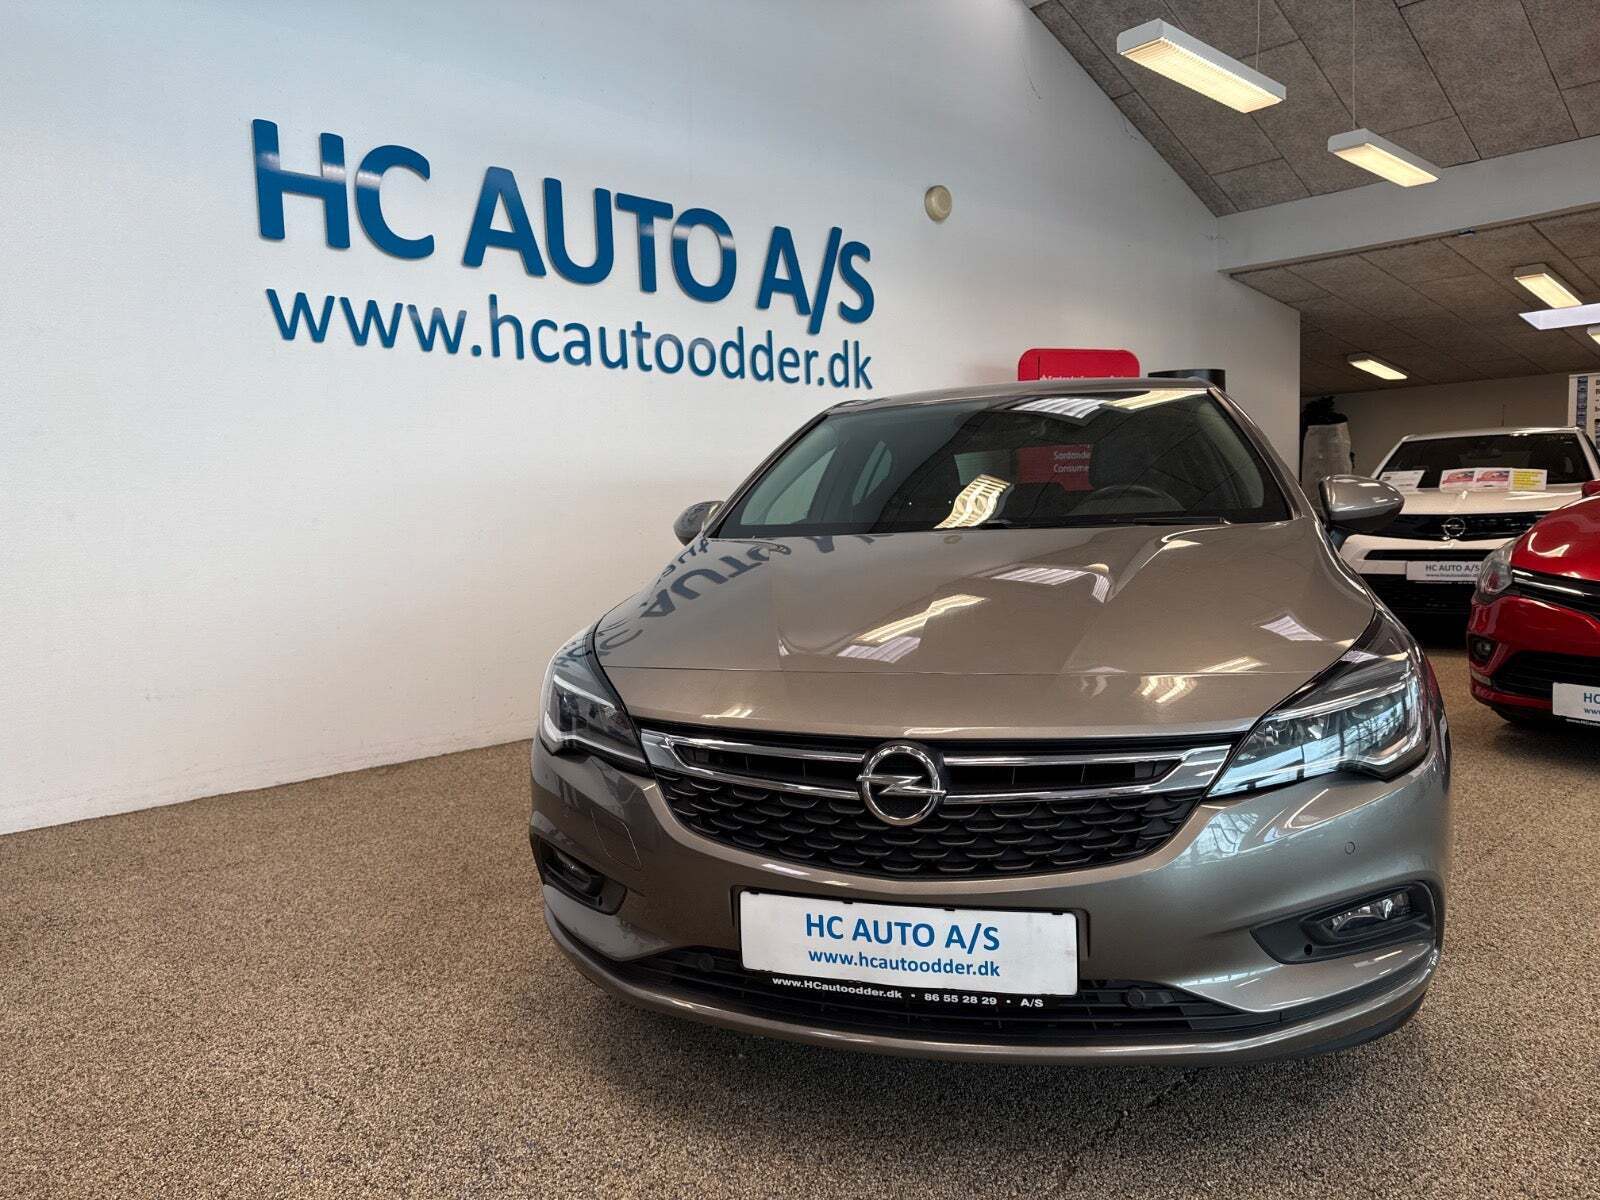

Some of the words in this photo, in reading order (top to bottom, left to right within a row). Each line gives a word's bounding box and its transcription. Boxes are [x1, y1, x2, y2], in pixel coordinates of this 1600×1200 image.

[251, 118, 435, 260] HC
[463, 166, 737, 302] AUTO
[757, 226, 875, 335] A/S
[266, 287, 873, 389] www.hcautoodder.dk
[1425, 564, 1438, 572] HC
[1439, 564, 1463, 572] AUTO
[805, 913, 844, 940] HC
[852, 918, 935, 948] AUTO
[944, 922, 1001, 955] A/S
[808, 950, 1000, 977] www.hcautoodder.dk
[772, 977, 903, 999] www.HCautoodder.dk
[924, 993, 940, 1002] 86
[943, 994, 959, 1003] 55
[962, 995, 978, 1004] 28
[981, 996, 998, 1005] 29
[1020, 998, 1044, 1007] A/S
